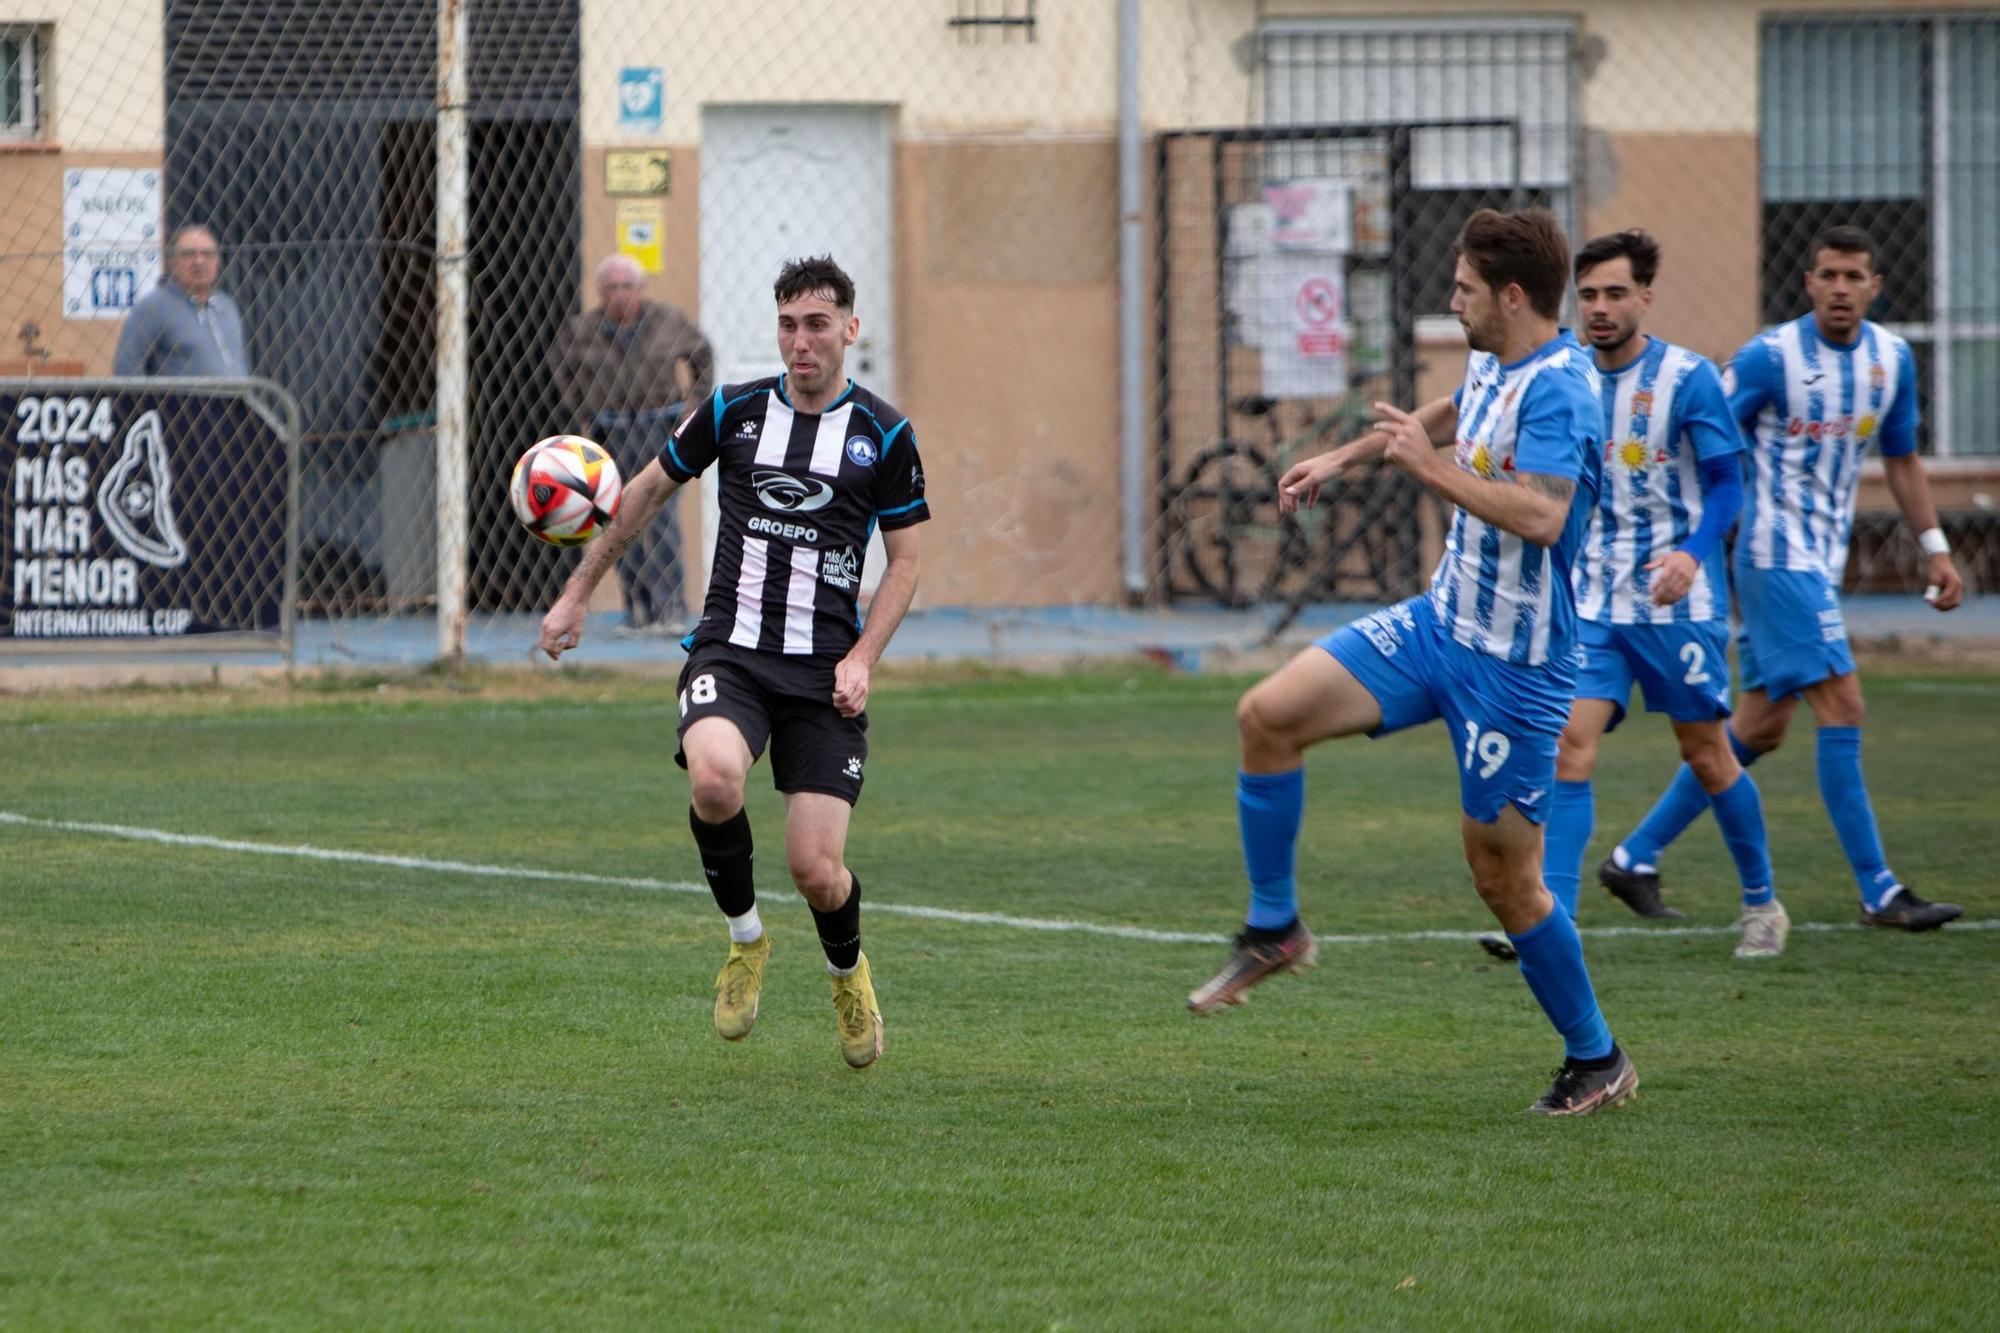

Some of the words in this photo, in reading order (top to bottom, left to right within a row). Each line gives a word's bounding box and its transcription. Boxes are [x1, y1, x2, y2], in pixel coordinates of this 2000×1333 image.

[17, 396, 115, 443] 2024
[14, 443, 89, 503] MÁS
[14, 506, 91, 553] MAR
[747, 516, 818, 543] GROEPO
[822, 562, 840, 575] MAR
[824, 549, 840, 564] MÁS
[14, 558, 139, 606] MENOR
[14, 608, 151, 637] INTERNATIONAL
[153, 607, 192, 635] CUP
[1679, 642, 1711, 685] 2
[1465, 719, 1511, 780] 19
